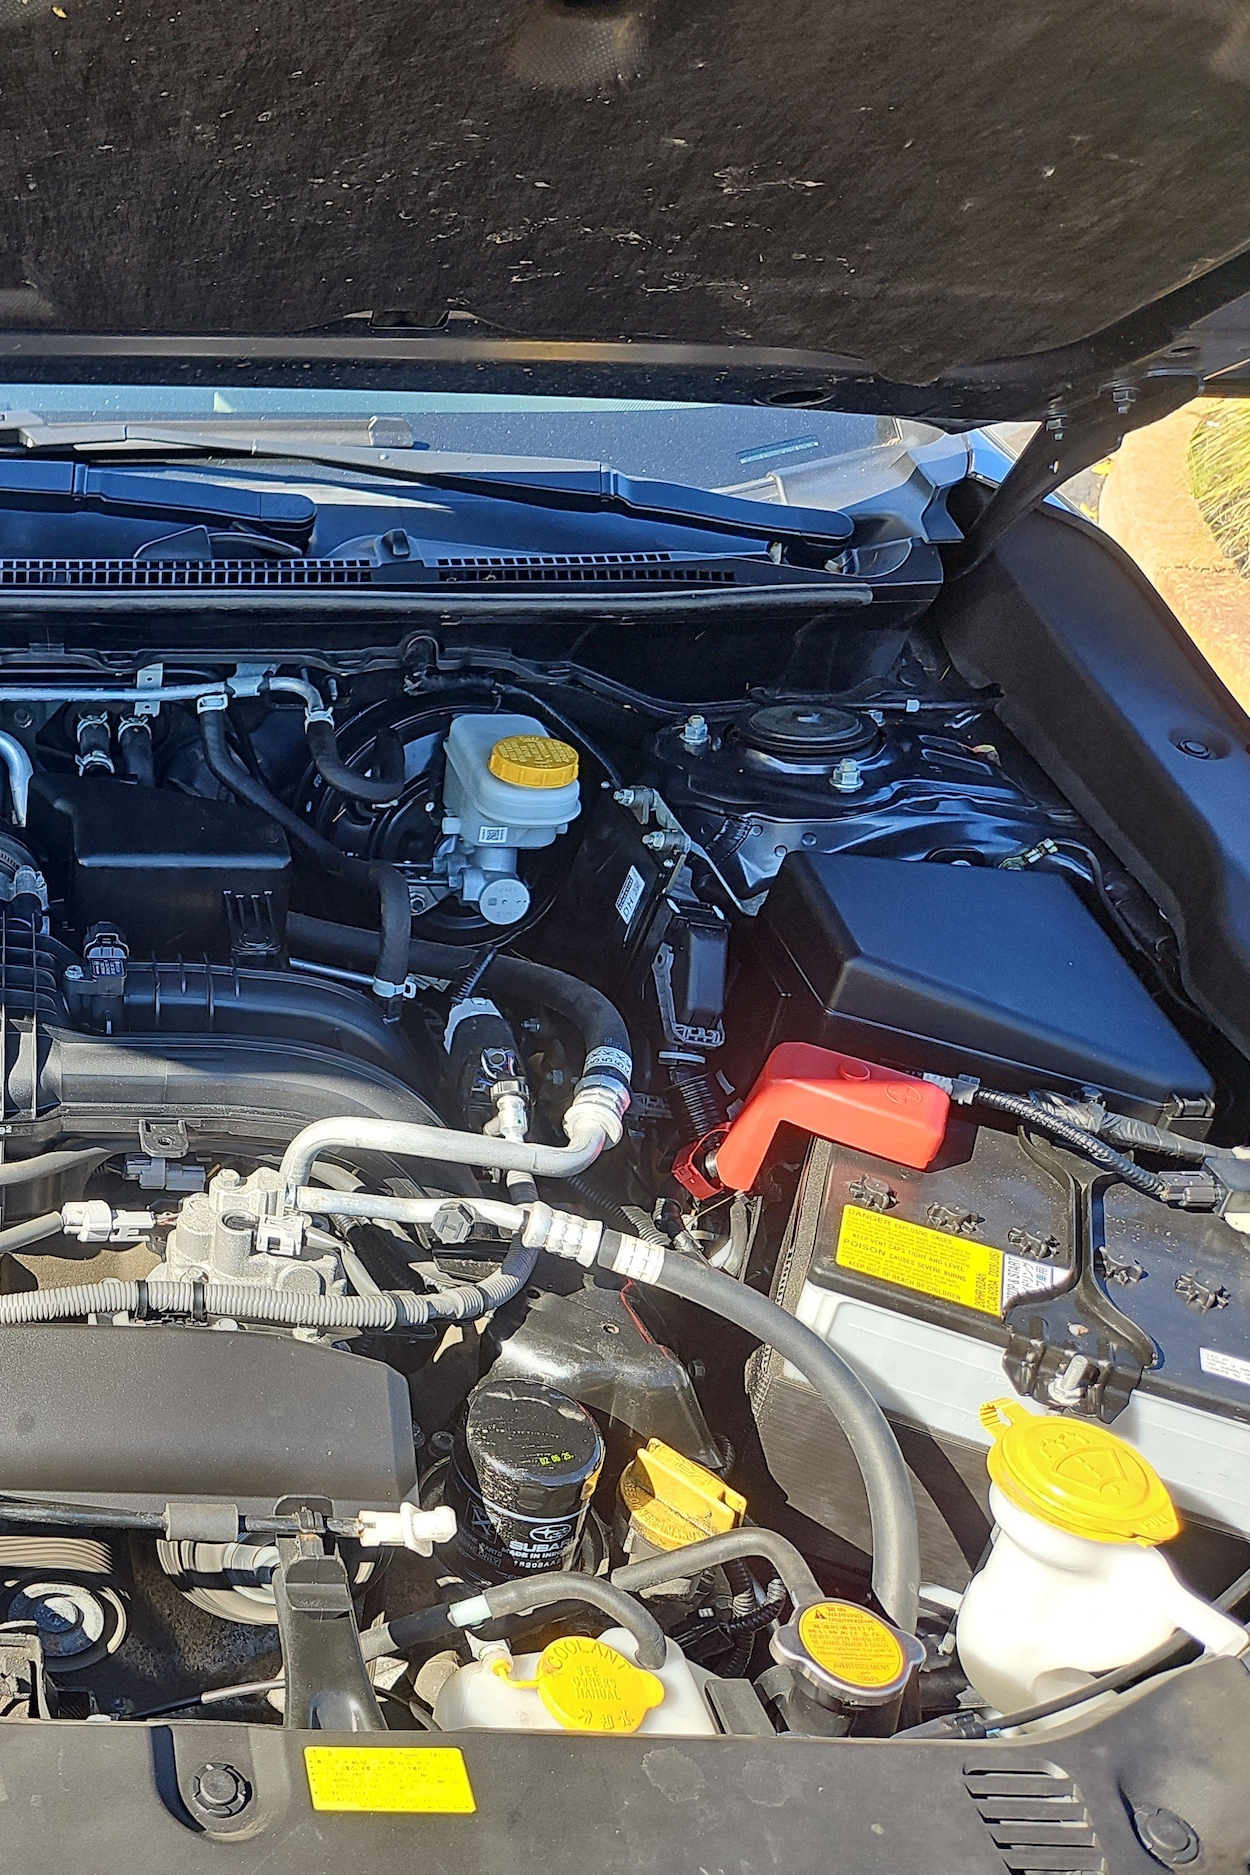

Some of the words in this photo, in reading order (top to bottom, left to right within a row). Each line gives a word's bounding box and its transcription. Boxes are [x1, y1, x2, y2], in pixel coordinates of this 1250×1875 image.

[848, 1208, 891, 1226] DANGER
[843, 1238, 886, 1256] POISON
[889, 1253, 915, 1266] CAUSES
[870, 1238, 887, 1248] VENT
[888, 1244, 906, 1254] CAPS
[908, 1249, 928, 1260] TIGHT
[928, 1255, 943, 1265] AND
[944, 1260, 965, 1272] LEVEL
[1008, 1256, 1020, 1278] START
[866, 1265, 881, 1275] OUT
[892, 1272, 915, 1286] REACH
[926, 1283, 962, 1300] CHILDREN
[622, 1480, 636, 1498] SEE
[501, 1547, 528, 1558] MADE
[542, 1550, 563, 1559] INDO
[509, 1537, 574, 1552] SUBAR
[547, 1640, 631, 1670] COOLANT
[576, 1666, 600, 1677] SEE
[573, 1676, 618, 1689] OWNERS
[576, 1688, 622, 1701] MANUAL
